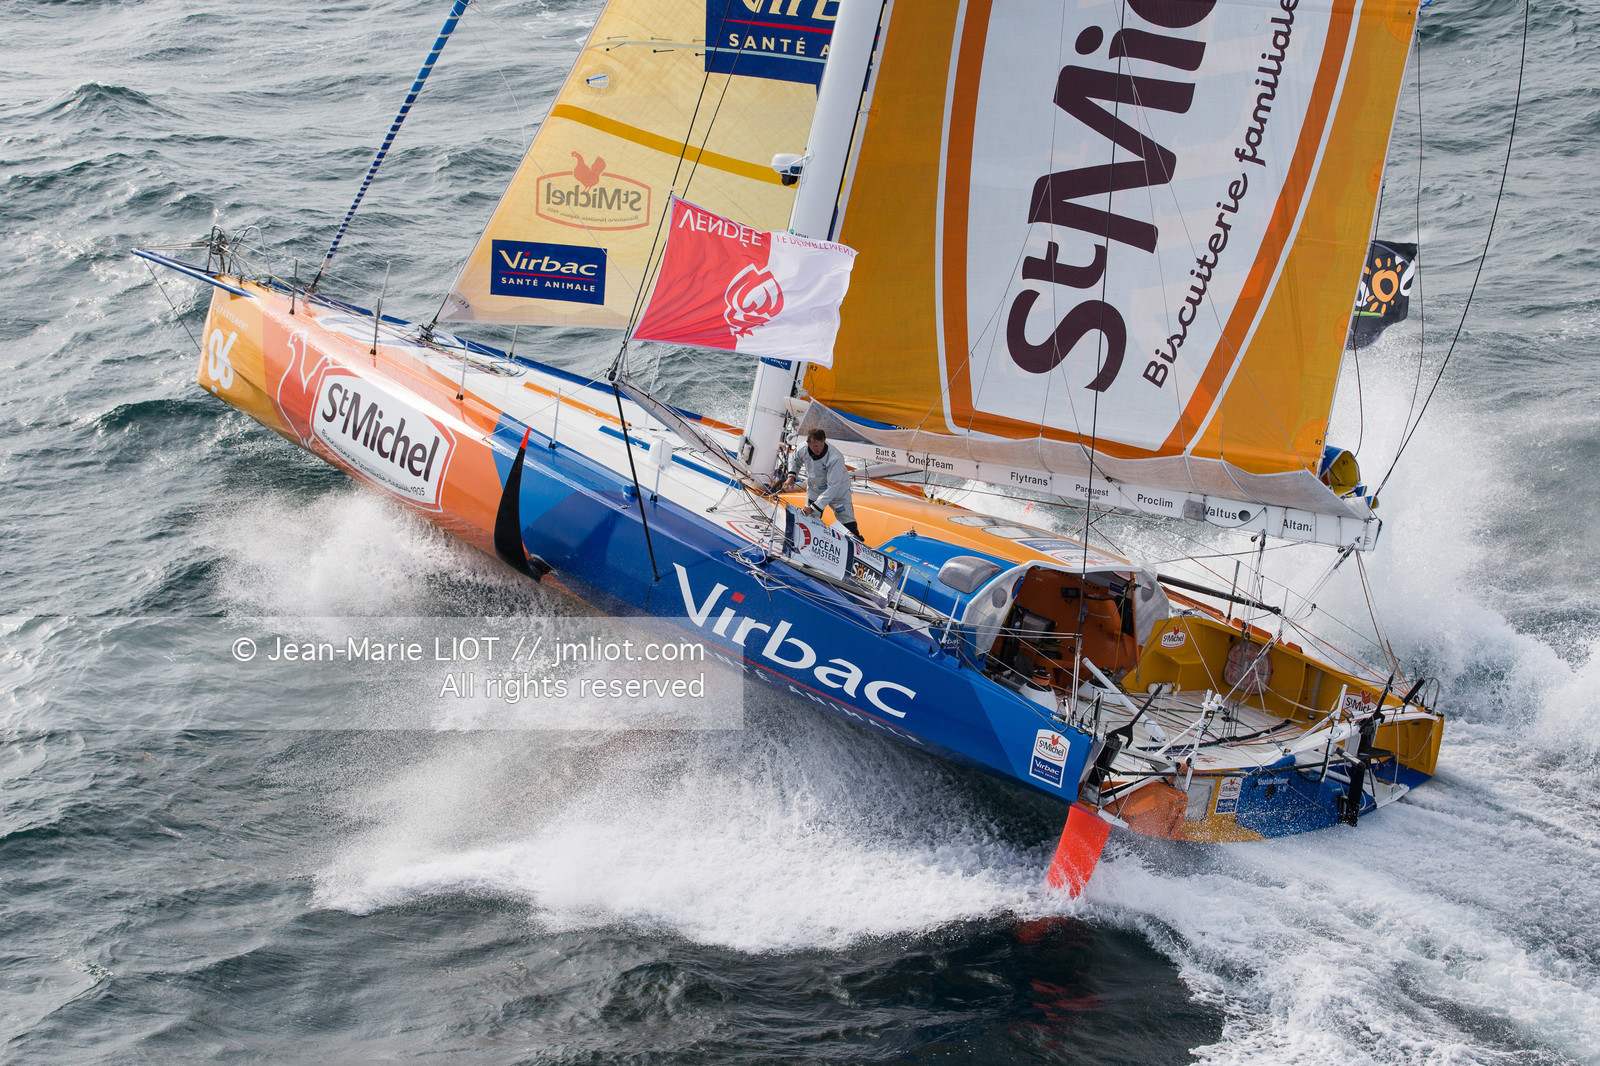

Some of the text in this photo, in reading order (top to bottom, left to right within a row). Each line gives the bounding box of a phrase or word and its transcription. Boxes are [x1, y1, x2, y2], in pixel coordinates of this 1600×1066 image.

[728, 33, 806, 55] SANTÉ
[498, 249, 598, 276] Virbac
[501, 276, 596, 293] SANTÉ ANIMALE
[1142, 172, 1248, 388] Biscuiterie
[321, 382, 441, 483] StMichel
[875, 447, 897, 458] Batt &
[908, 454, 954, 471] One2Team
[1010, 471, 1049, 487] Flytrans
[1075, 483, 1109, 497] Parquest
[1137, 493, 1174, 509] Proclim
[811, 545, 840, 565] MASTERS
[812, 536, 841, 557] OCEAN
[672, 562, 917, 719] Virbac
[1038, 739, 1065, 757] StMichel
[1034, 758, 1060, 776] Virbac
